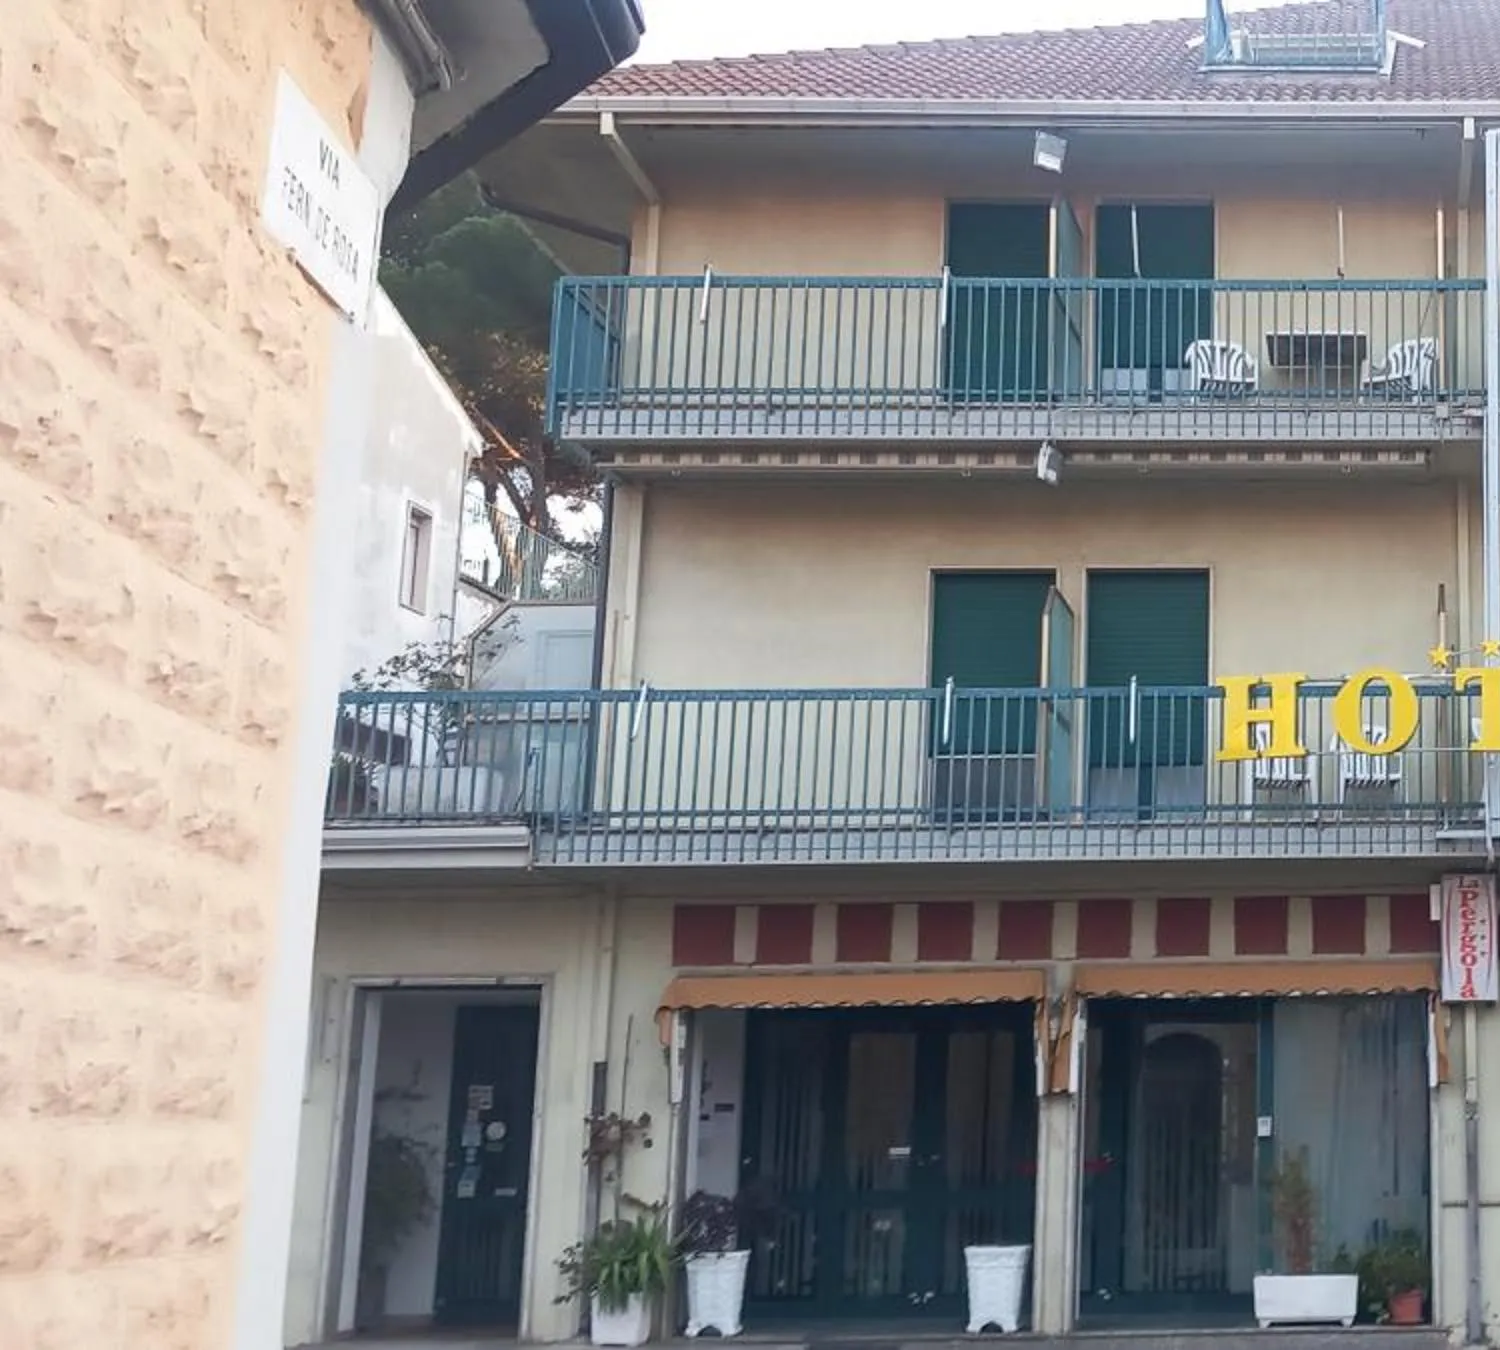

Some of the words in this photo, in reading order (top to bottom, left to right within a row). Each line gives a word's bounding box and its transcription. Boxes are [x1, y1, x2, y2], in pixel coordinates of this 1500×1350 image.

[318, 137, 340, 190] VIA
[1457, 876, 1479, 888] La
[1459, 890, 1478, 999] Pergola
